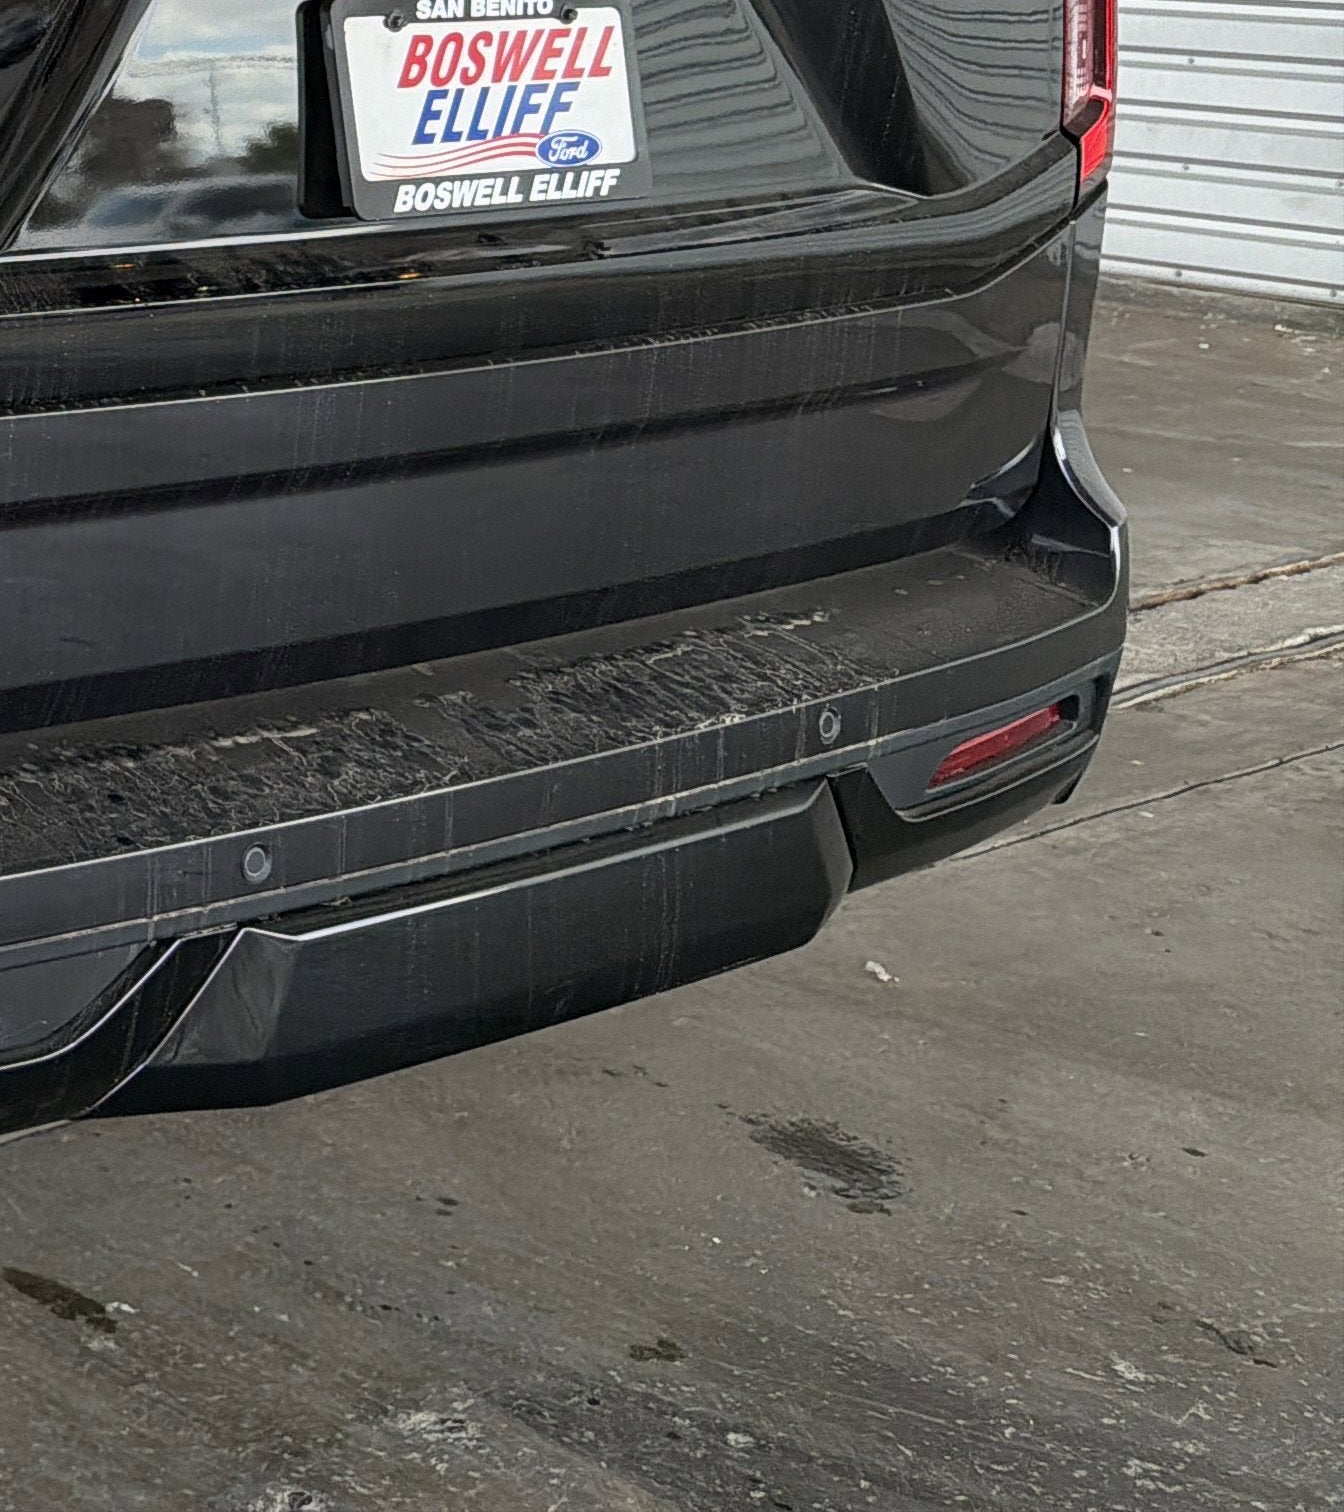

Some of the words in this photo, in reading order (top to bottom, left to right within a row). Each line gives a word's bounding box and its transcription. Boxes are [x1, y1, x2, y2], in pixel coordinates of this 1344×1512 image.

[396, 25, 615, 89] BOSWELL
[411, 81, 580, 145] ELLIFF
[548, 137, 589, 162] Ford
[393, 176, 524, 214] BOSWELL
[529, 168, 621, 202] ELLIFF
